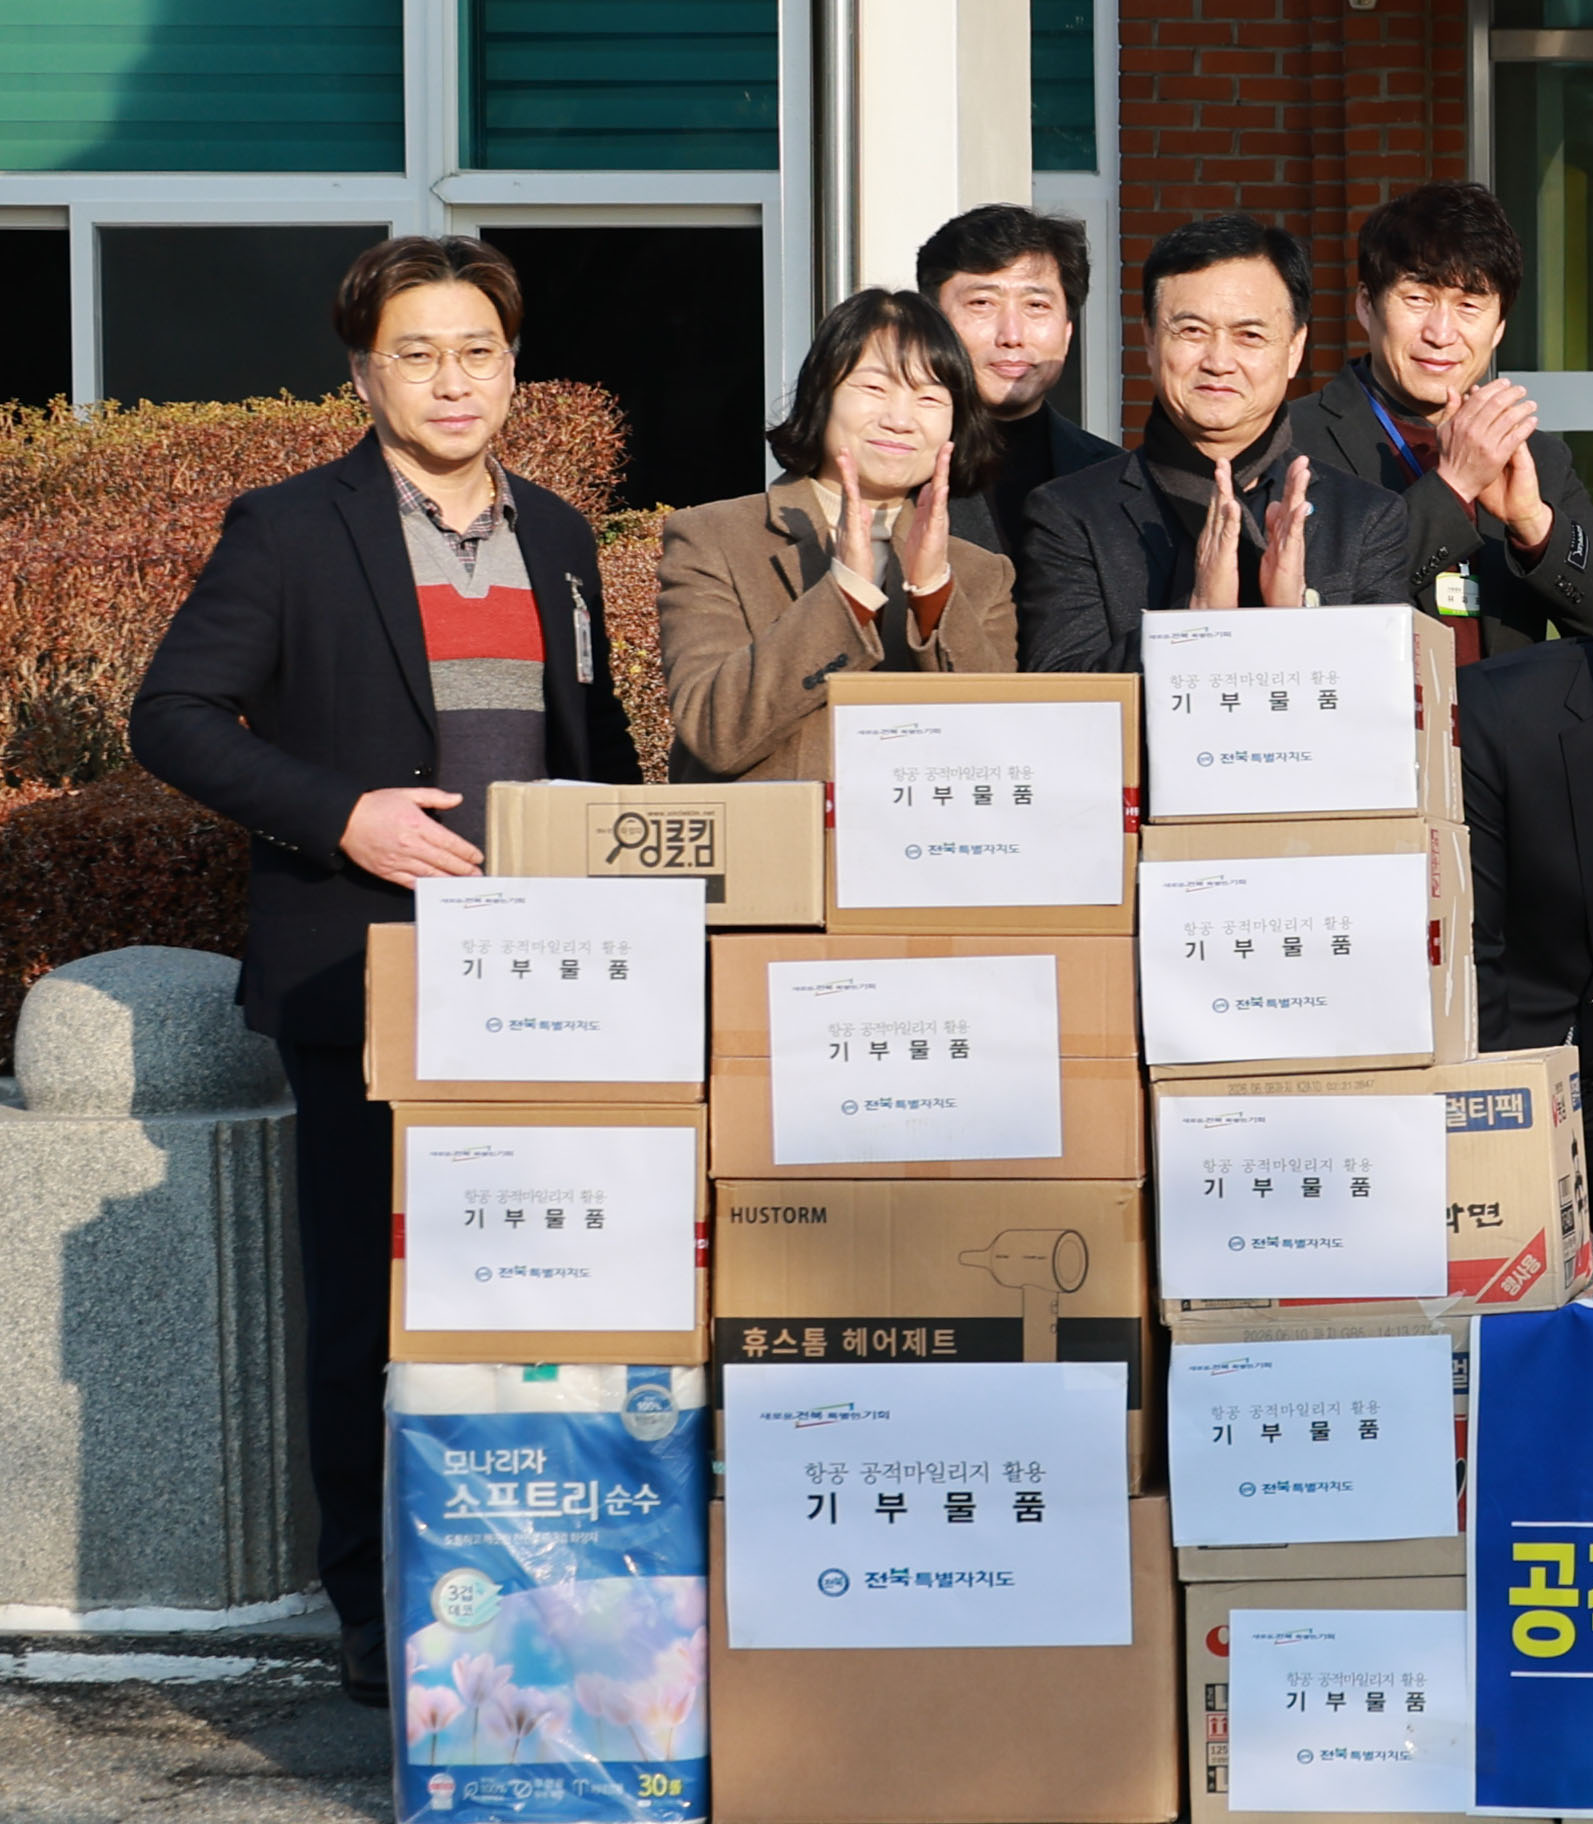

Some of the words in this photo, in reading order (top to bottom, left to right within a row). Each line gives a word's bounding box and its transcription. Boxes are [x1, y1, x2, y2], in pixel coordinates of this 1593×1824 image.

[730, 1206, 828, 1224] HUSTORM
[1500, 1253, 1541, 1297] 행사용
[741, 1326, 828, 1358] 휴스톰
[842, 1326, 958, 1358] 헤어제트
[443, 1448, 547, 1476] 모나리자
[804, 1461, 850, 1486] 항공
[859, 1460, 989, 1486] 공적마일리지
[1001, 1459, 1047, 1484] 활용
[443, 1480, 599, 1522] 소프트리
[604, 1484, 662, 1516] 순수
